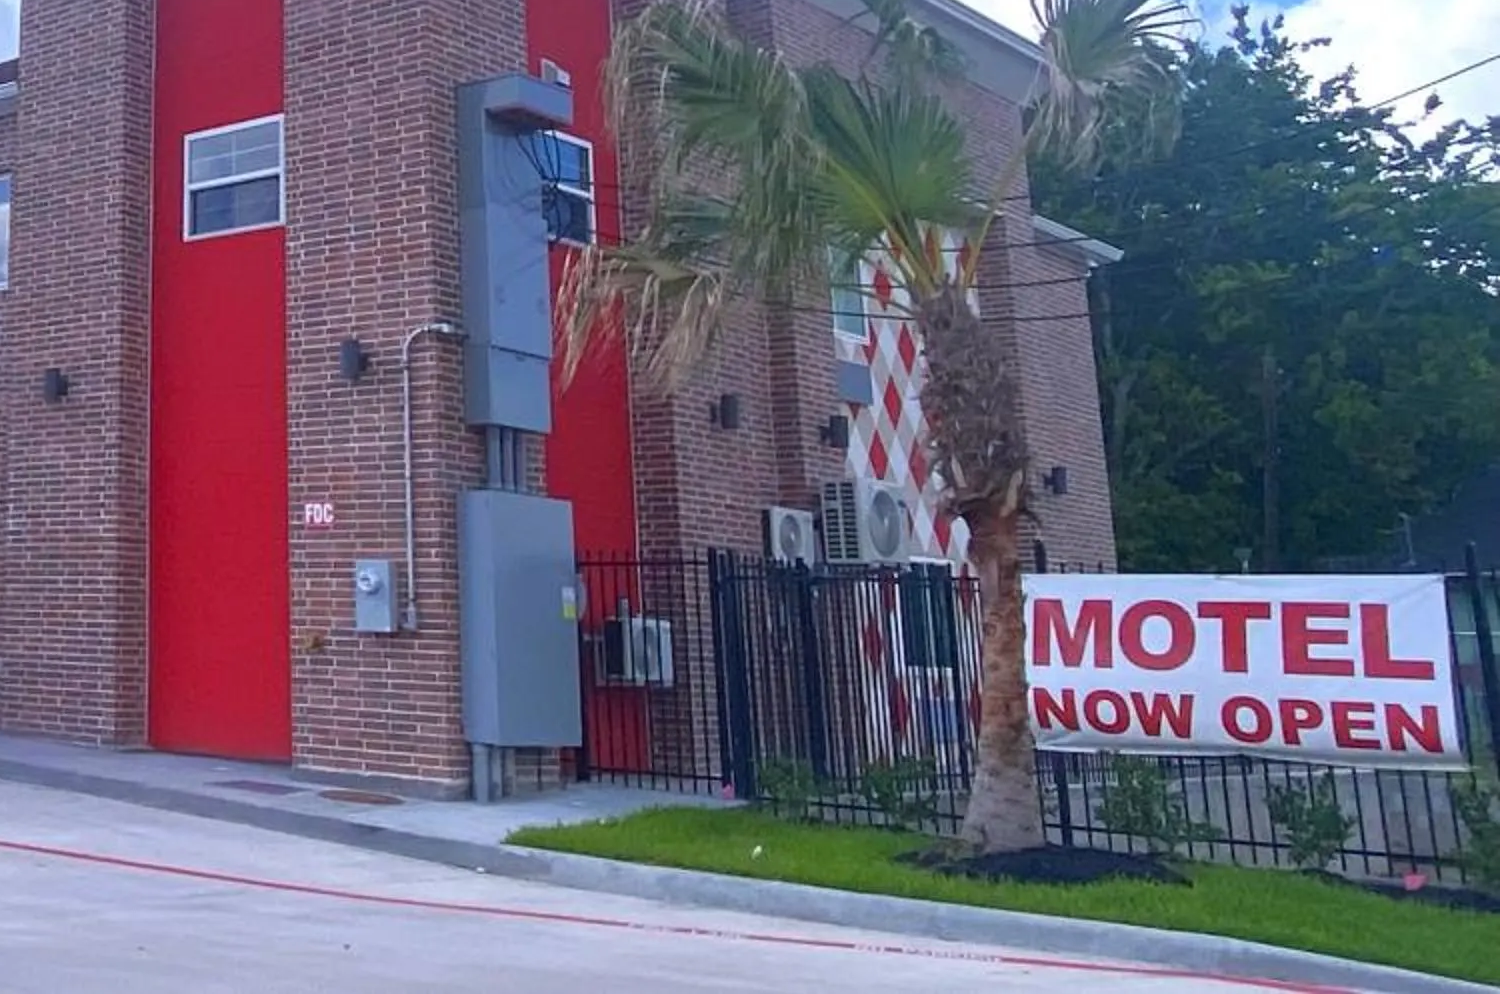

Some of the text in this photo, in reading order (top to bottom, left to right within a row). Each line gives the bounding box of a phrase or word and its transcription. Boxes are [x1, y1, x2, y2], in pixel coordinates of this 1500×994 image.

[304, 503, 334, 523] FDC
[1032, 598, 1435, 681] MOTEL
[1032, 686, 1444, 753] NOW OPEN
